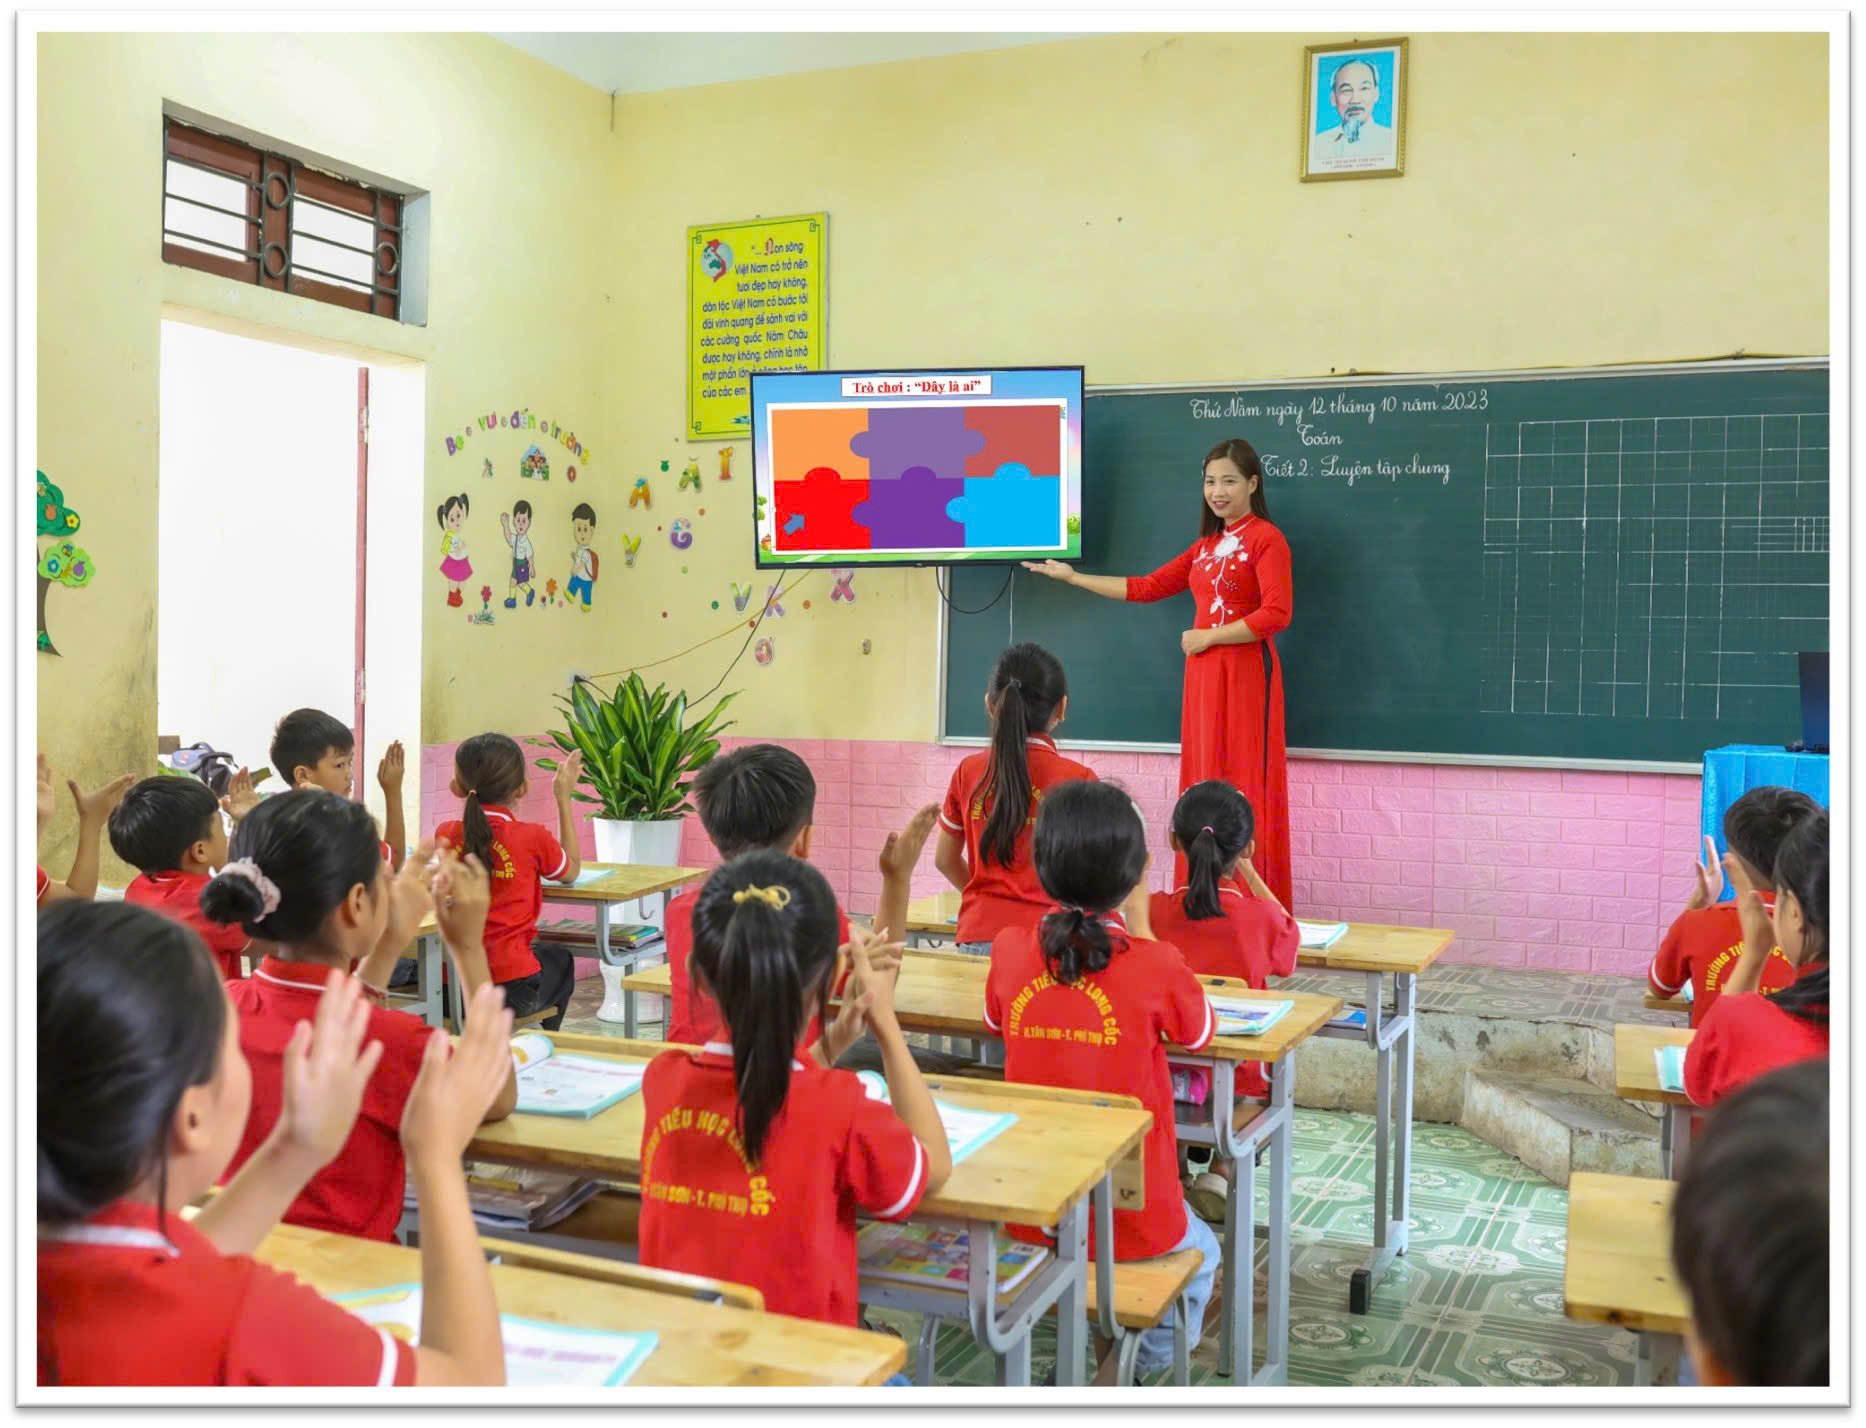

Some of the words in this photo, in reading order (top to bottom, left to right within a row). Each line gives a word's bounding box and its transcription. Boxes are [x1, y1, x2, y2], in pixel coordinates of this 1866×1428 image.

[786, 241, 804, 254] sông
[735, 263, 749, 275] Việt
[750, 264, 768, 273] Nam
[770, 261, 780, 272] có
[794, 260, 808, 269] nên
[752, 280, 766, 293] đẹp
[768, 280, 782, 290] hay
[703, 302, 717, 312] dân
[732, 300, 746, 310] Việt
[748, 298, 765, 308] Nam
[766, 296, 776, 308] có
[716, 318, 730, 328] vinh
[731, 318, 754, 328] quang
[767, 312, 782, 324] sánh
[785, 312, 795, 322] vai
[700, 336, 714, 346] các
[744, 330, 762, 344] quốc
[788, 328, 808, 340] Châu
[722, 352, 736, 363] hay
[764, 347, 784, 359] chính
[785, 346, 792, 358] là
[702, 370, 715, 382] một
[703, 386, 716, 398] của
[718, 386, 732, 396] các
[852, 382, 874, 392] Trò
[877, 382, 903, 392] chơi
[949, 381, 960, 392] là
[1189, 398, 1222, 419] Thứ
[1266, 400, 1304, 426] ngày
[1308, 396, 1328, 415] 12
[1330, 392, 1376, 424] tháng
[1380, 396, 1397, 412] 10
[1402, 398, 1439, 412] năm
[1442, 388, 1488, 410] 2023
[1296, 423, 1344, 446] Toán
[1260, 454, 1295, 477] Tiết
[1320, 455, 1374, 486] Luyện
[1404, 452, 1451, 486] chung
[1085, 981, 1112, 1016] LONG
[696, 1110, 729, 1136] HỌC
[748, 1176, 777, 1216] CỐC
